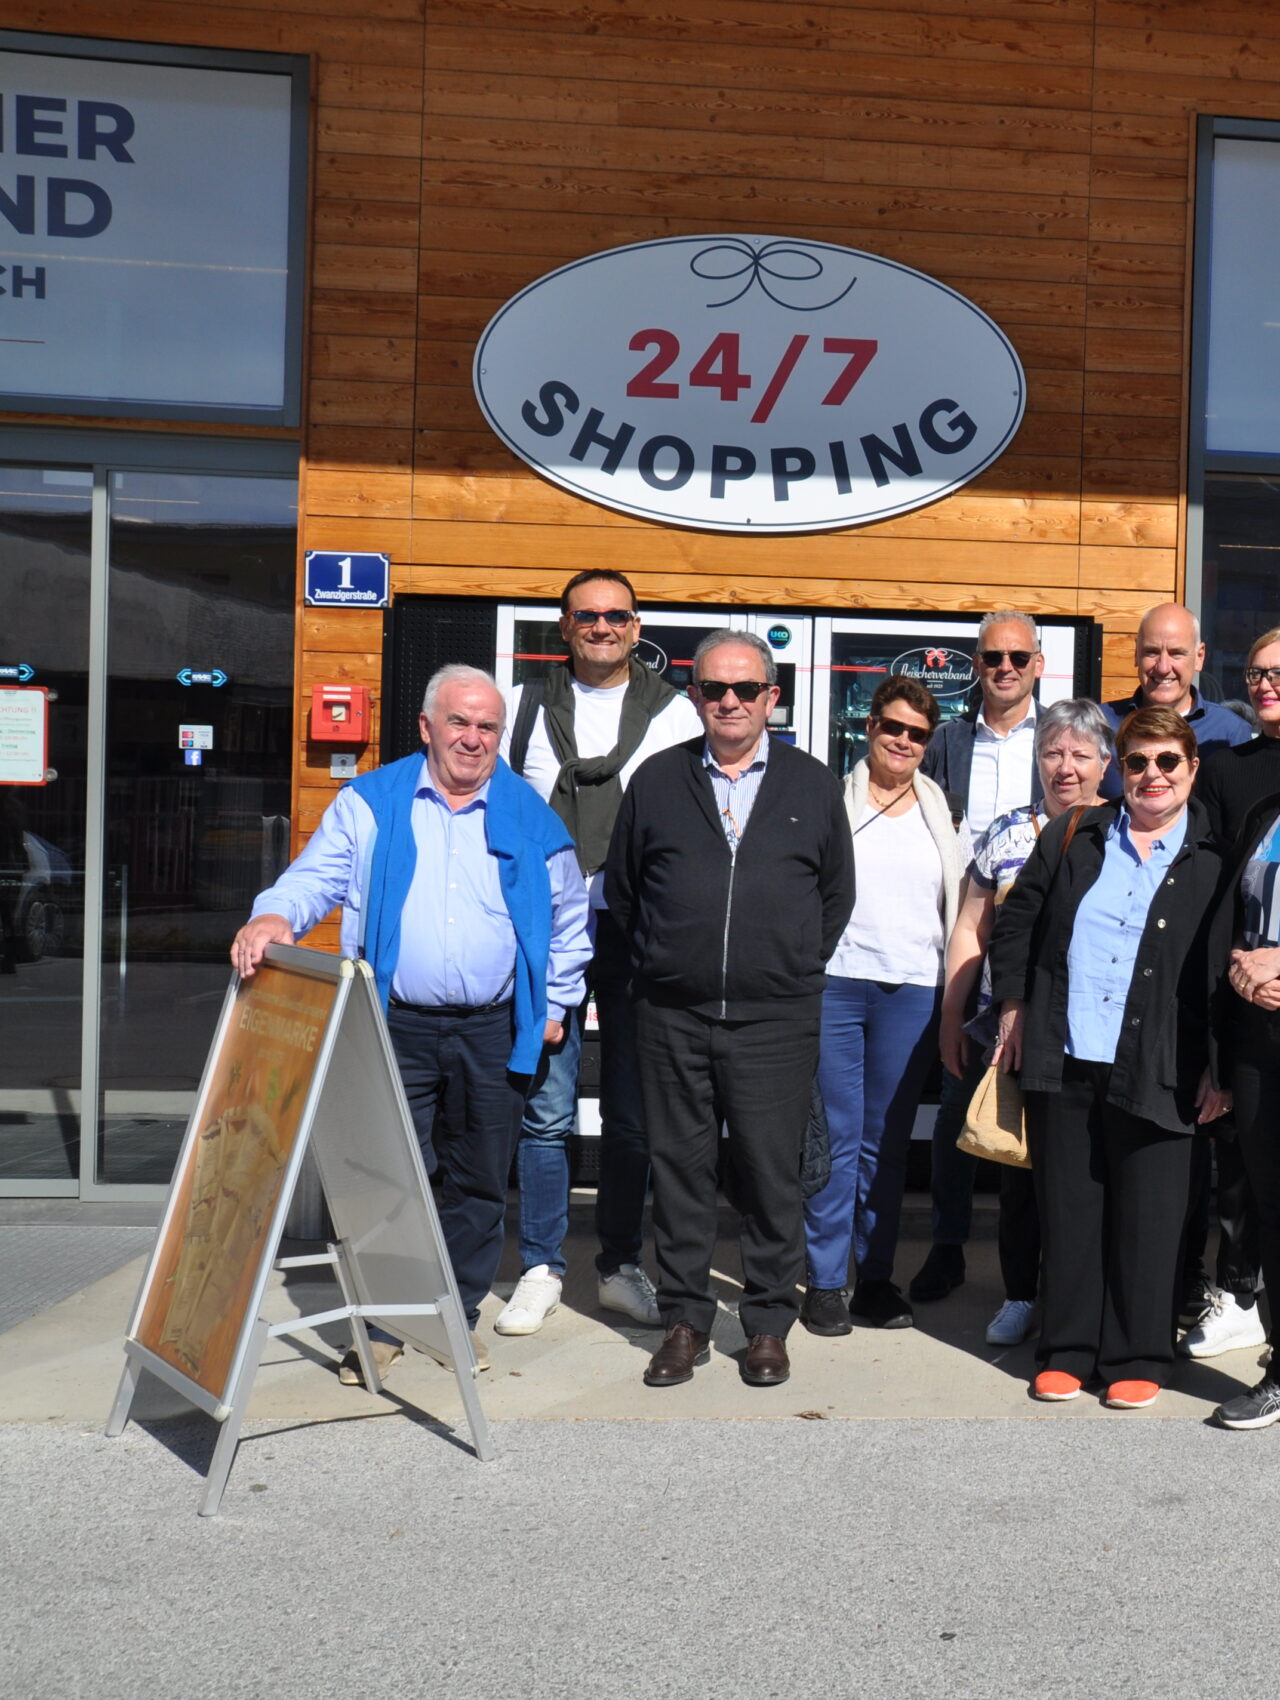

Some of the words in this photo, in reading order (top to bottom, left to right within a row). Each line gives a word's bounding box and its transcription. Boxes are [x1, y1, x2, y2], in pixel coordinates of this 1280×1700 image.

[0, 93, 135, 163] ER
[626, 328, 878, 424] 24/7
[521, 380, 978, 502] SHOPPING
[314, 588, 378, 602] Zwanzigerstraße
[337, 557, 354, 588] 1
